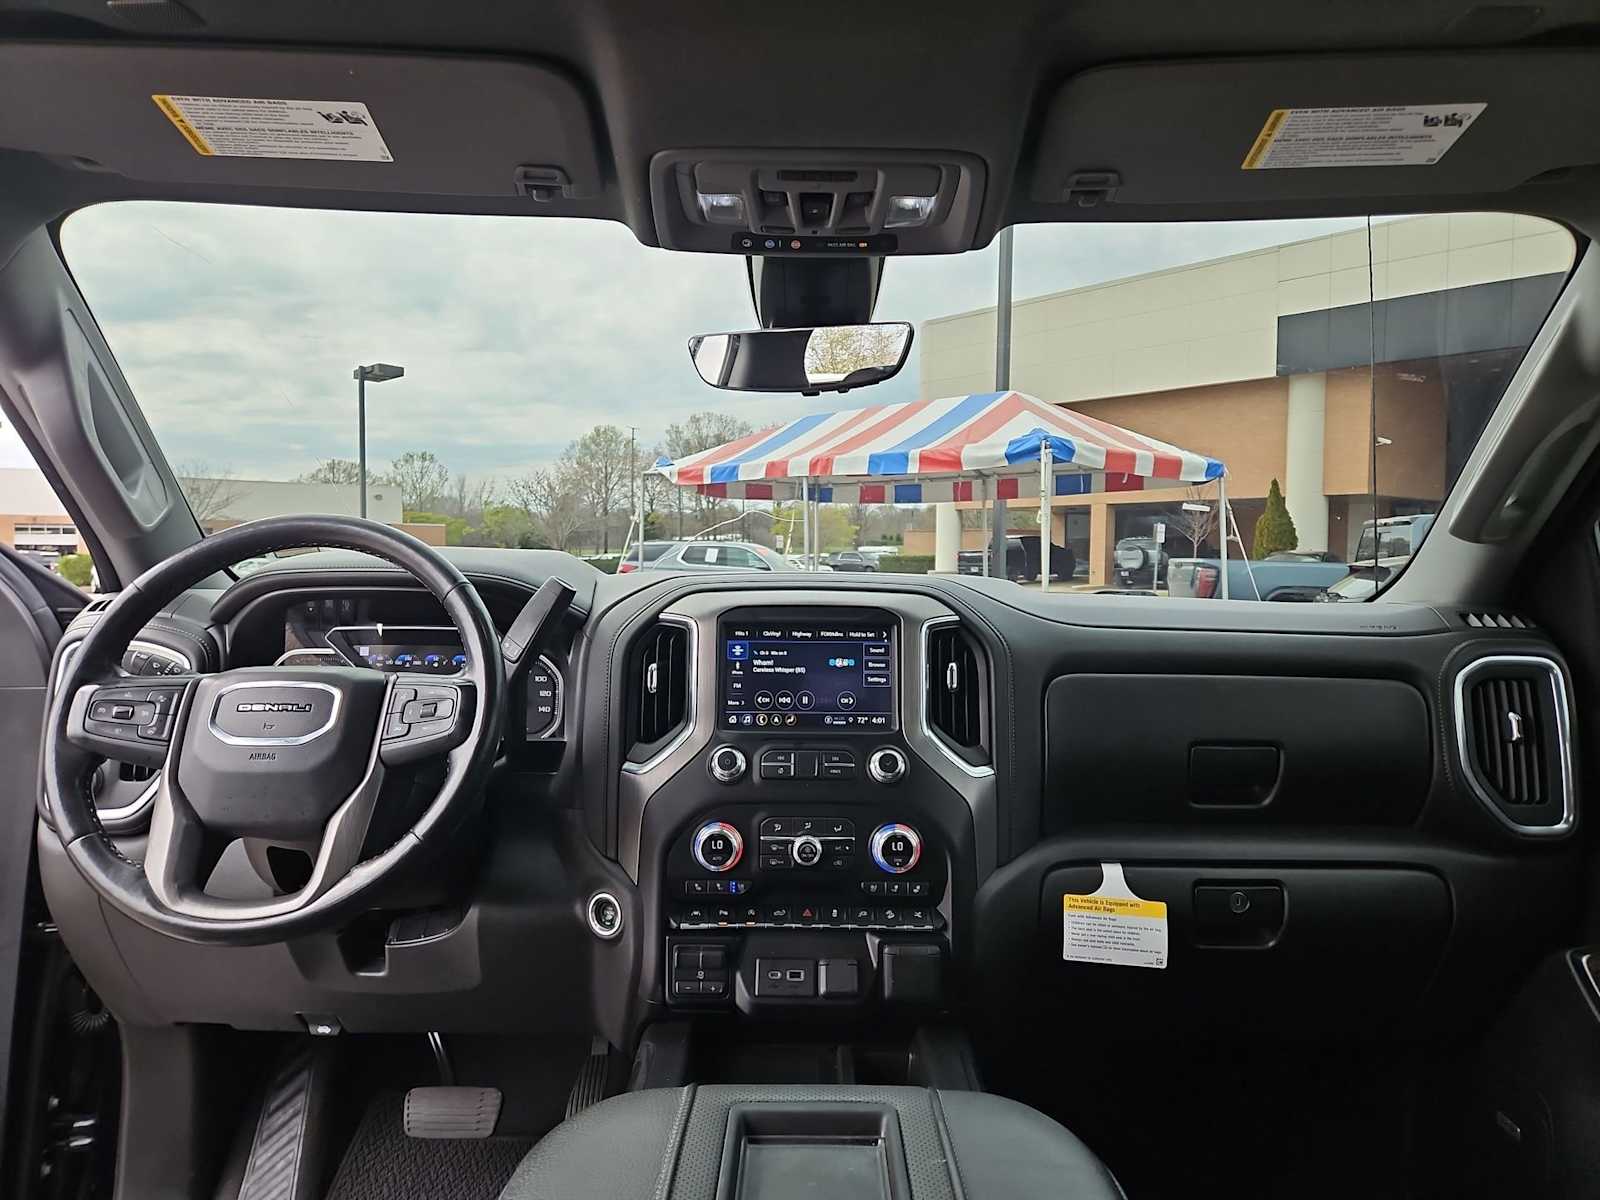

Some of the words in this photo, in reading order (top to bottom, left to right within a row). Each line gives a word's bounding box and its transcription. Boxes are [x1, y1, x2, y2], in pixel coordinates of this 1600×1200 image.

[237, 703, 313, 712] DENALI
[249, 752, 276, 761] AIRBAG
[1080, 897, 1099, 905] Vehicle
[1105, 900, 1129, 908] Equipped
